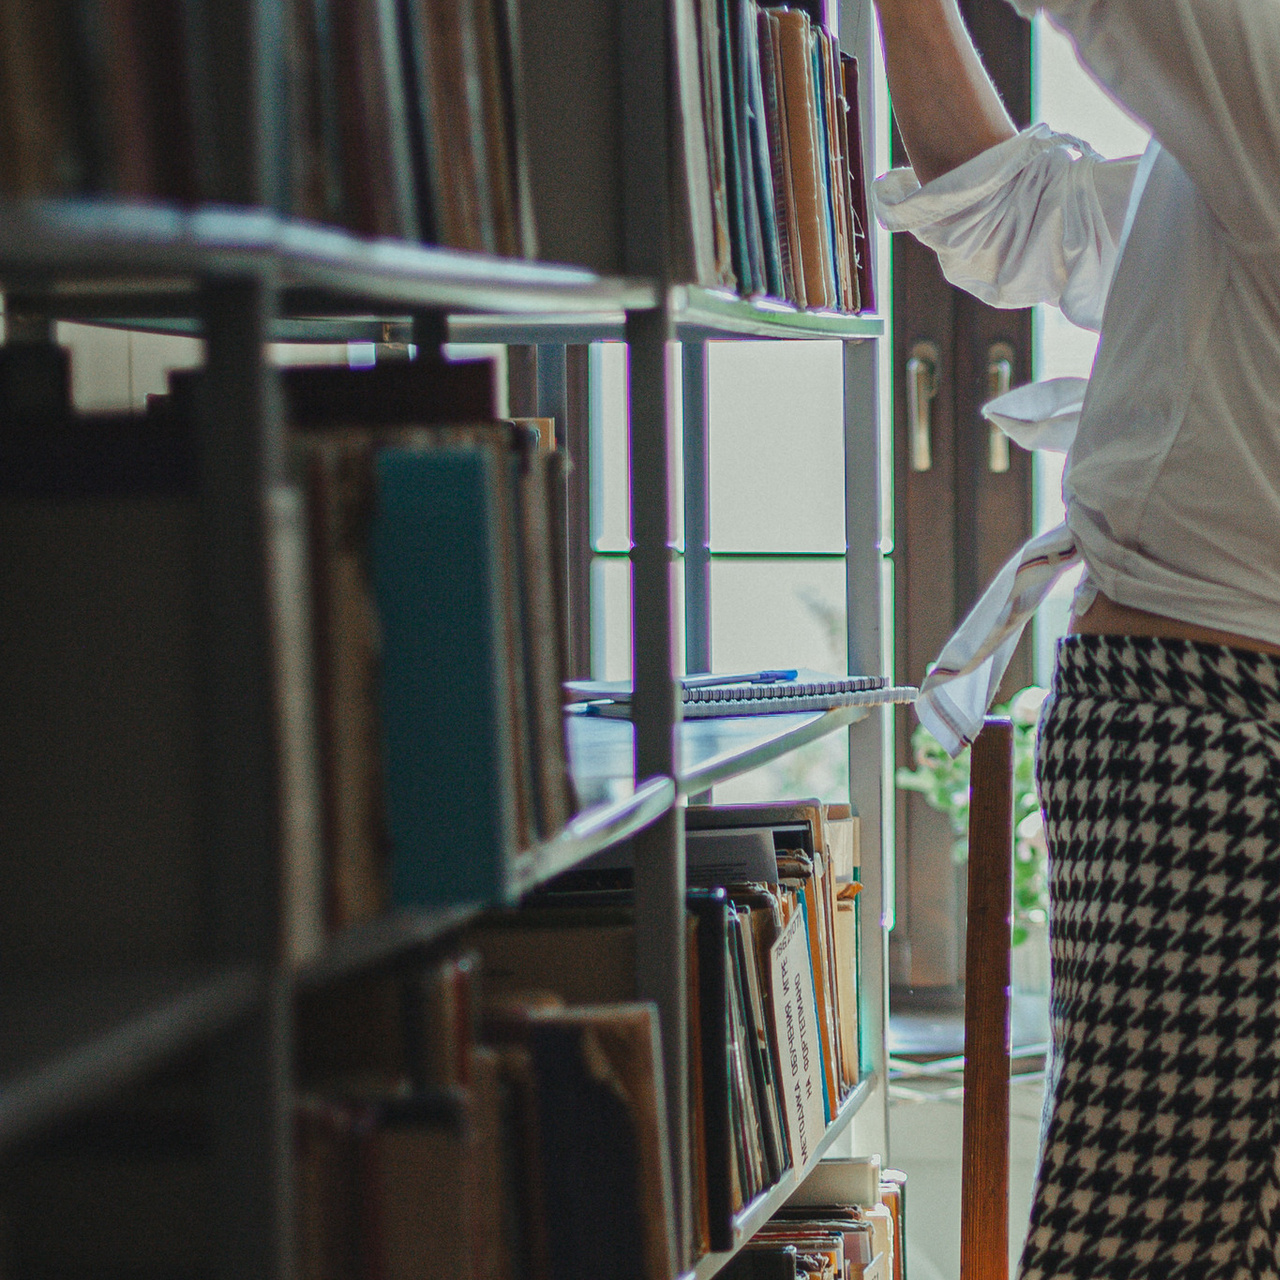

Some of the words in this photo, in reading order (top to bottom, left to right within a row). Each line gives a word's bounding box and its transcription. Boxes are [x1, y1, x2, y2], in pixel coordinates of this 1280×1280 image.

[780, 955, 790, 996] ИГРЕ
[785, 1000, 799, 1077] ОБУЧЕНИЯ
[794, 972, 810, 1072] ФОРТЕПИАНО
[794, 1079, 808, 1166] МЕТОДИКА
[804, 1075, 813, 1100] НА
